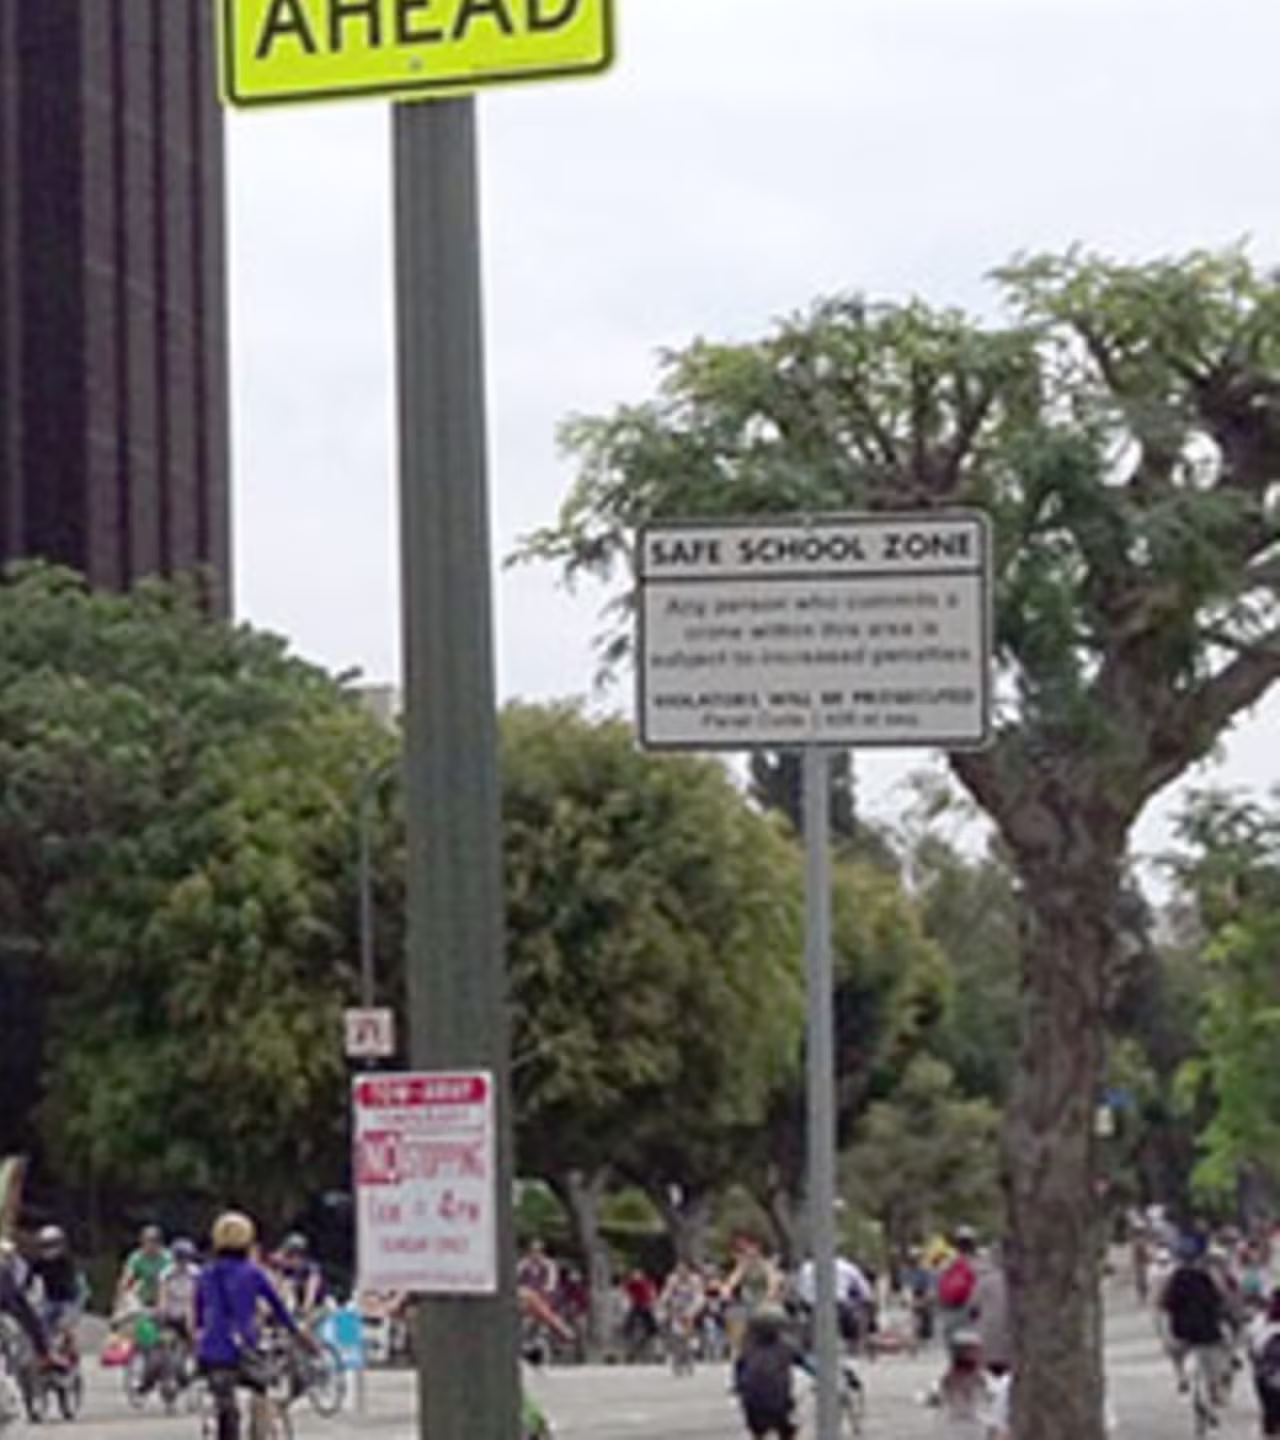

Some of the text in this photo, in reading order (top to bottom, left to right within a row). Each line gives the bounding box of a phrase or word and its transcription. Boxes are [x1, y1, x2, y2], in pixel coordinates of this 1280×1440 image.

[650, 531, 971, 566] SAFE SCHOOL ZONE
